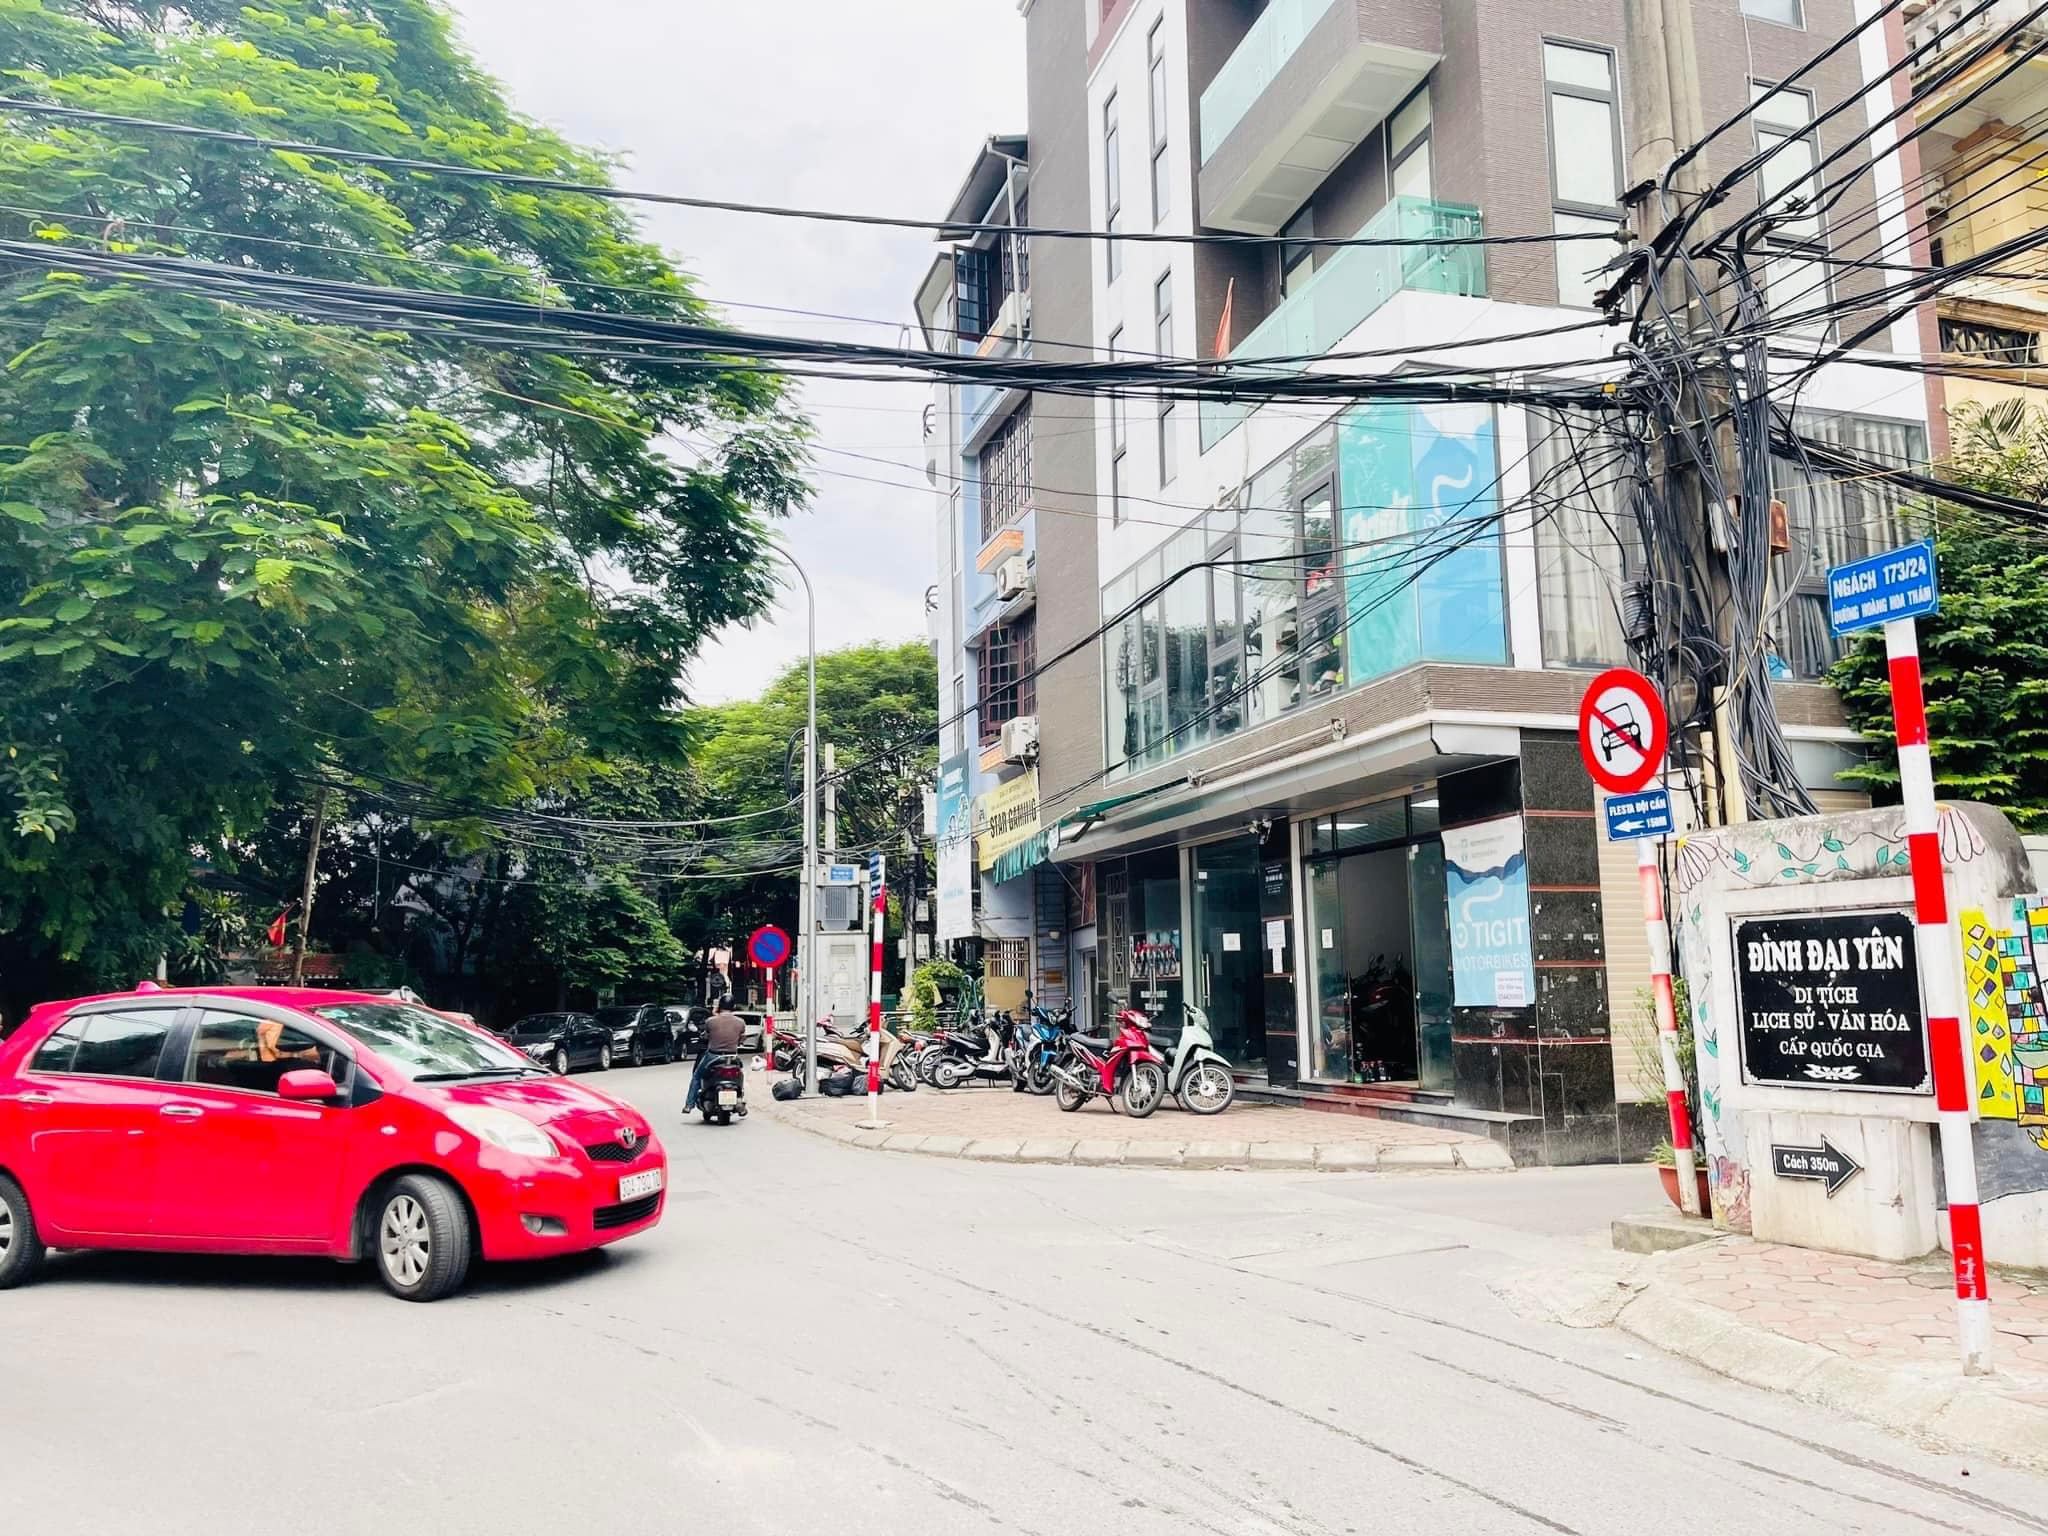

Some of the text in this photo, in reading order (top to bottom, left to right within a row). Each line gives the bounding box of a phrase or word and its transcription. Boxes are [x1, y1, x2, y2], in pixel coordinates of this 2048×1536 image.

[1833, 556, 1927, 599] NGÁCH 173/24
[990, 812, 1008, 838] STAR
[1472, 917, 1525, 947] TIGIT
[1748, 926, 1903, 979] ĐÌNH ĐẠI YÊN
[1794, 983, 1858, 1005] DI TÍCH
[1752, 1012, 1791, 1033] LỊCH
[1793, 1007, 1817, 1031] SỬ
[1828, 1008, 1865, 1031] VĂN
[1870, 1008, 1911, 1031] HÓA
[1779, 1036, 1885, 1058] CẤP QUỐC GIA
[1783, 1153, 1839, 1172] Cách 350m
